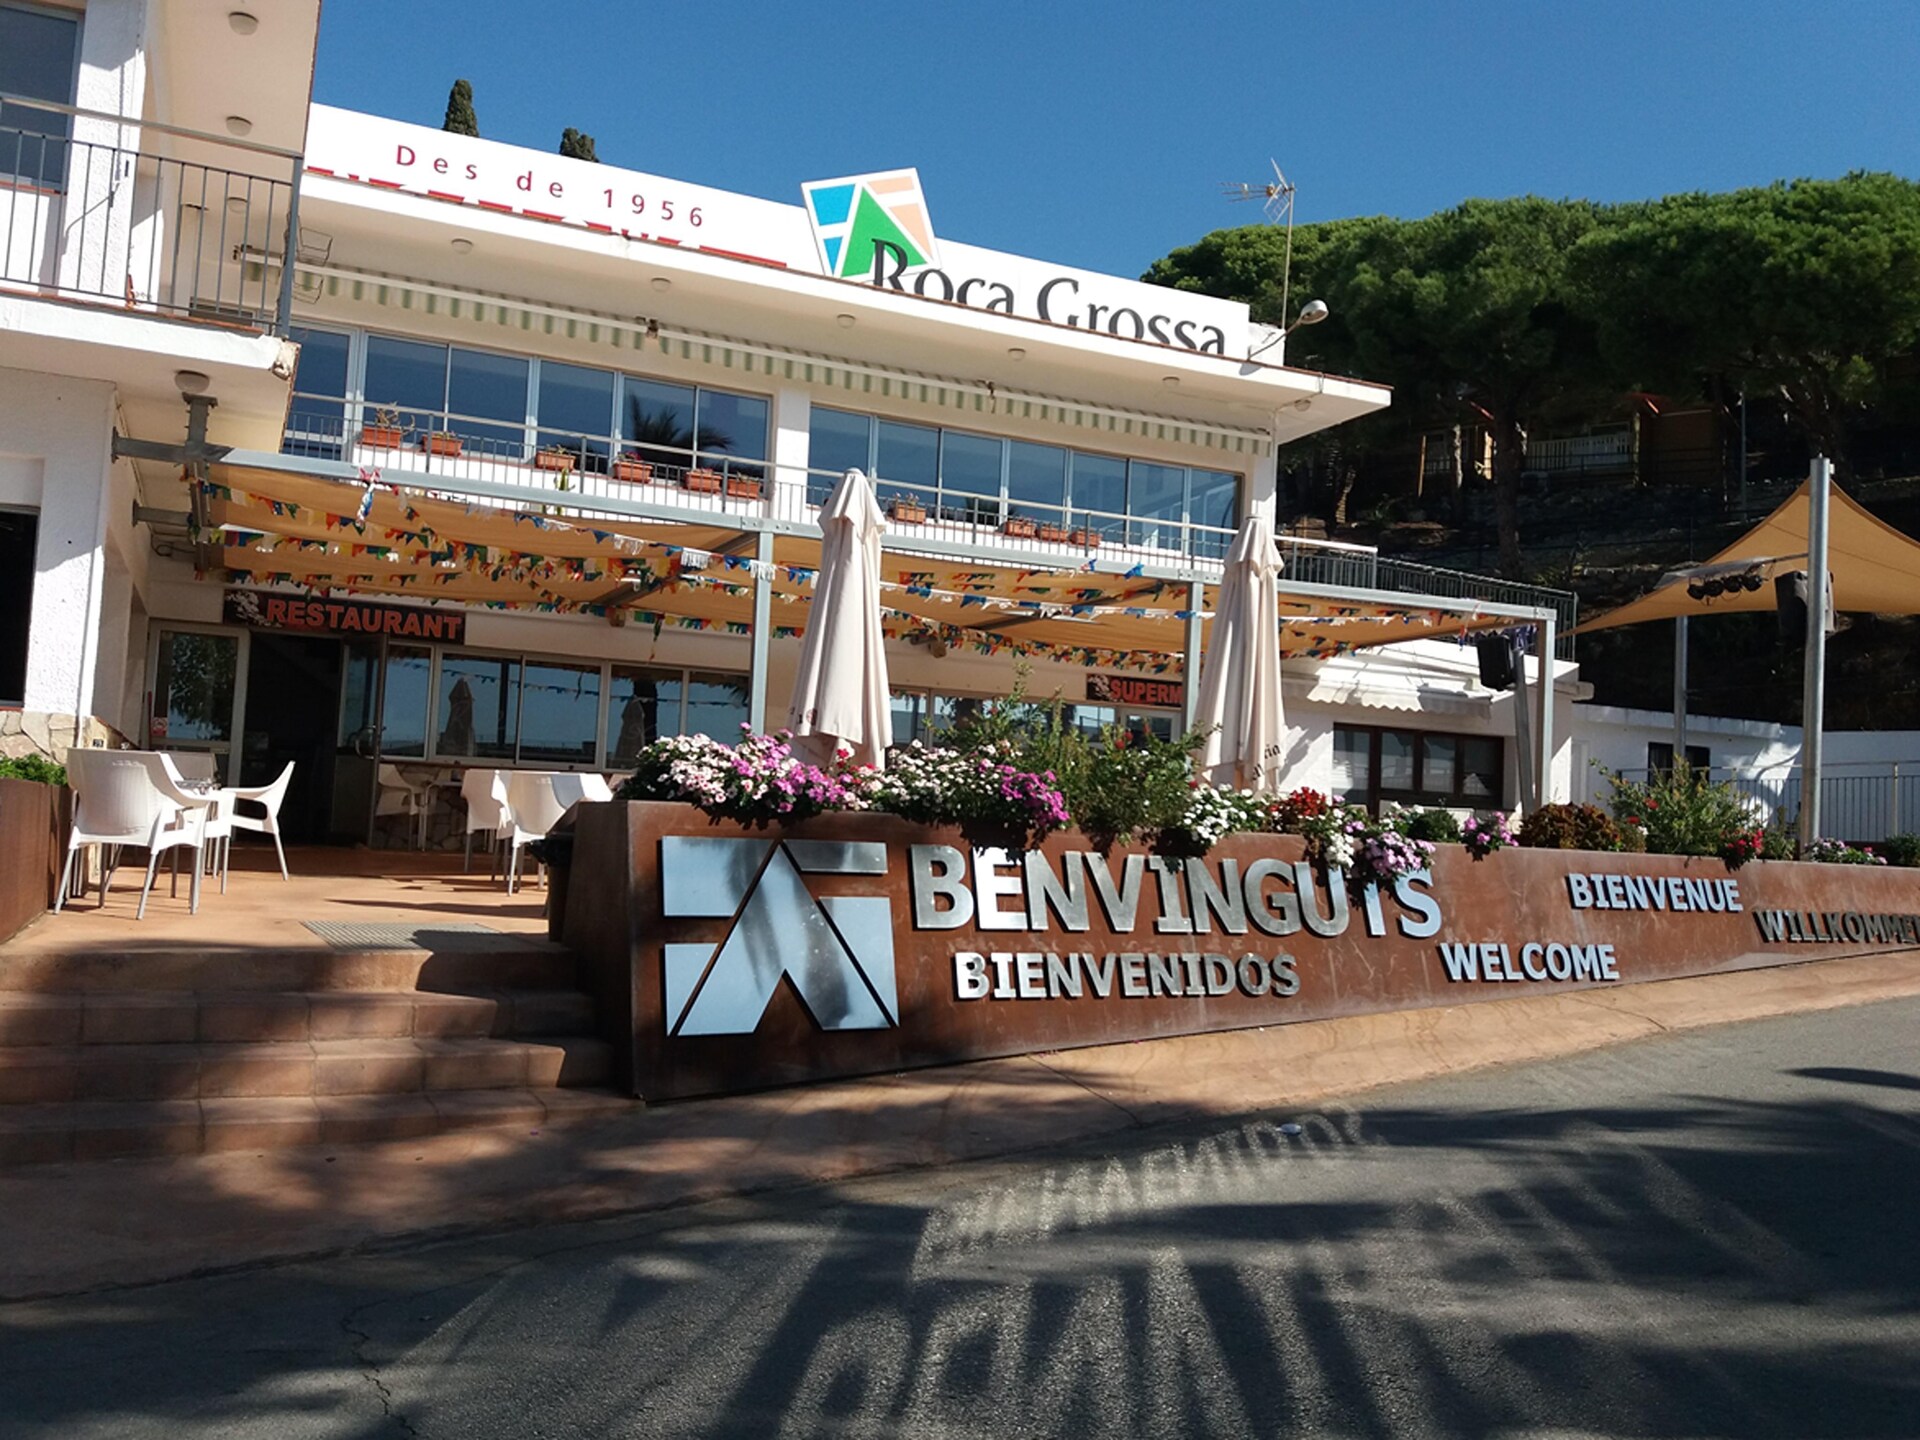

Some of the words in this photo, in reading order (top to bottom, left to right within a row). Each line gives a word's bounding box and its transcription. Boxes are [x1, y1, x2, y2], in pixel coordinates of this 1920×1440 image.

[396, 144, 478, 181] Des
[516, 170, 564, 199] de
[603, 187, 704, 228] 1956
[871, 237, 1015, 316] Roca
[1036, 276, 1226, 356] Grossa
[266, 598, 462, 640] RESTAURANT
[1568, 873, 1743, 913] BIENVENUE
[955, 951, 1300, 999] BIENVENIDOS
[1440, 942, 1620, 981] WELCOME
